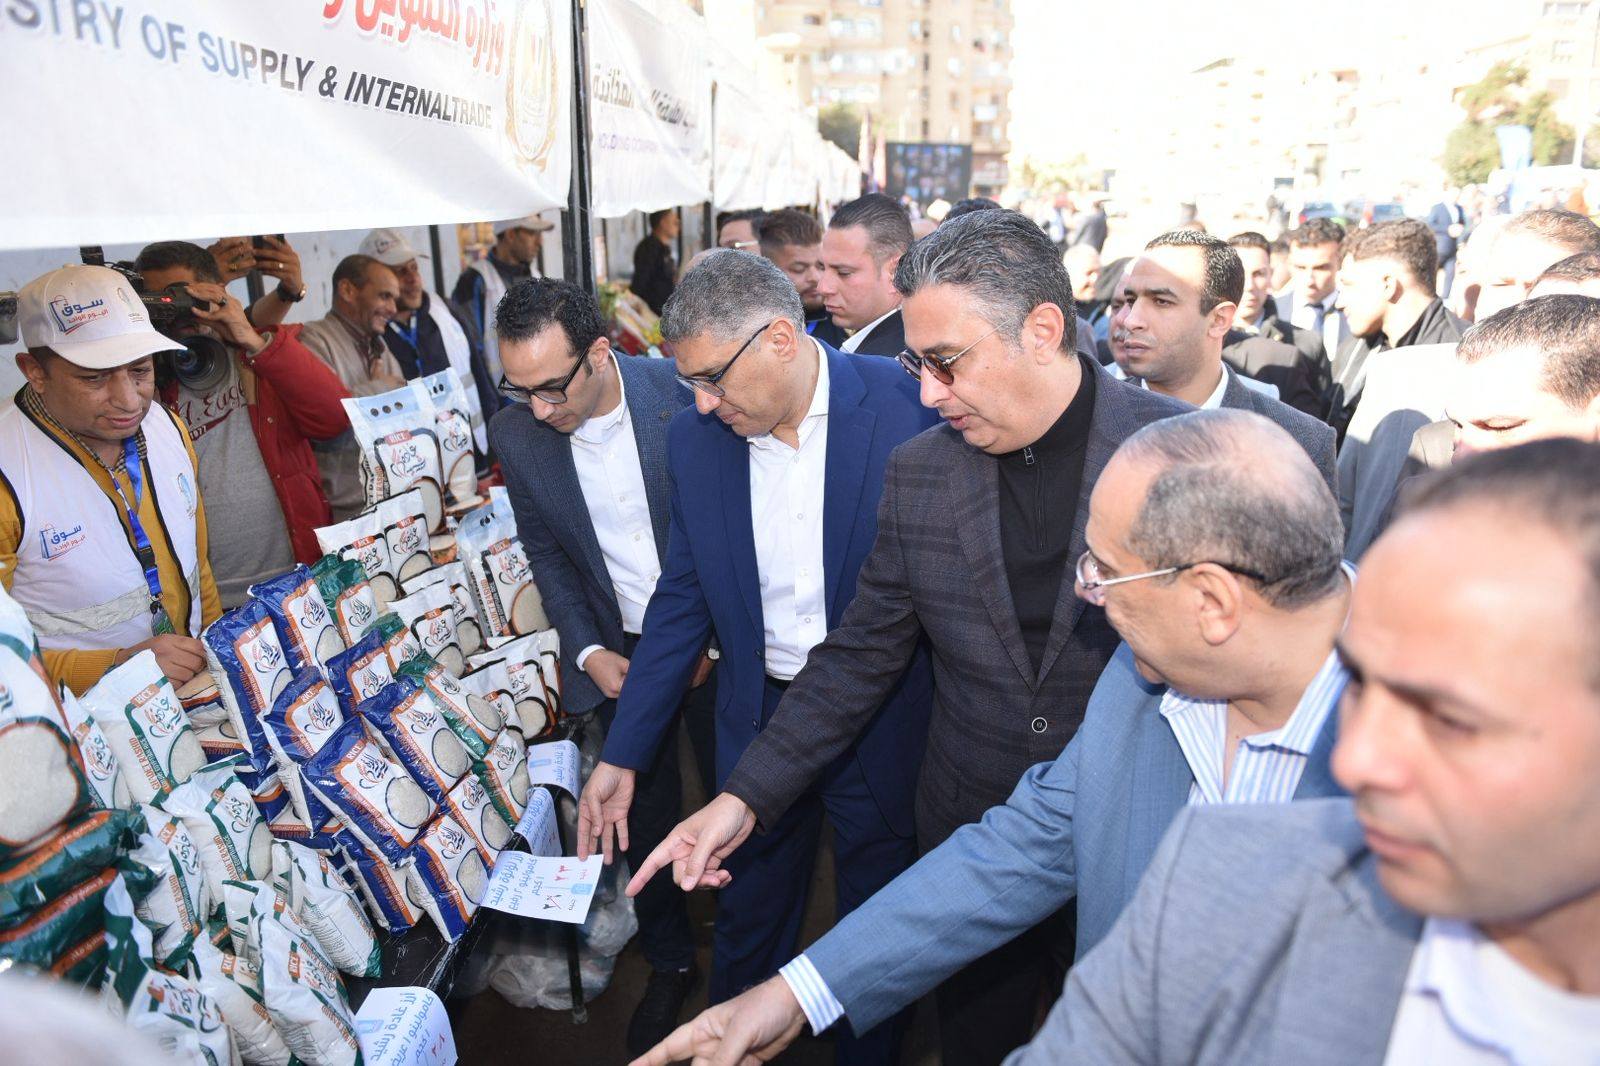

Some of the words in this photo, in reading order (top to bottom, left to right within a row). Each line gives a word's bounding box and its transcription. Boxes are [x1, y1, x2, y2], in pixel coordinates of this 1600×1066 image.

[141, 14, 187, 63] OF
[201, 31, 315, 93] SUPPLY
[318, 65, 338, 98] &
[62, 299, 104, 317] سوق
[86, 308, 109, 320] اليوم
[51, 525, 82, 545] سوق
[134, 687, 155, 705] RICE
[301, 685, 318, 703] RICE
[129, 737, 148, 764] RASHID
[346, 741, 363, 759] RICE
[519, 856, 538, 888] كامولينو
[490, 884, 509, 906] رشيد
[384, 1006, 407, 1031] غادة
[408, 994, 434, 1039] كامولينو
[370, 1033, 396, 1061] رشيد
[415, 1037, 428, 1063] كجم
